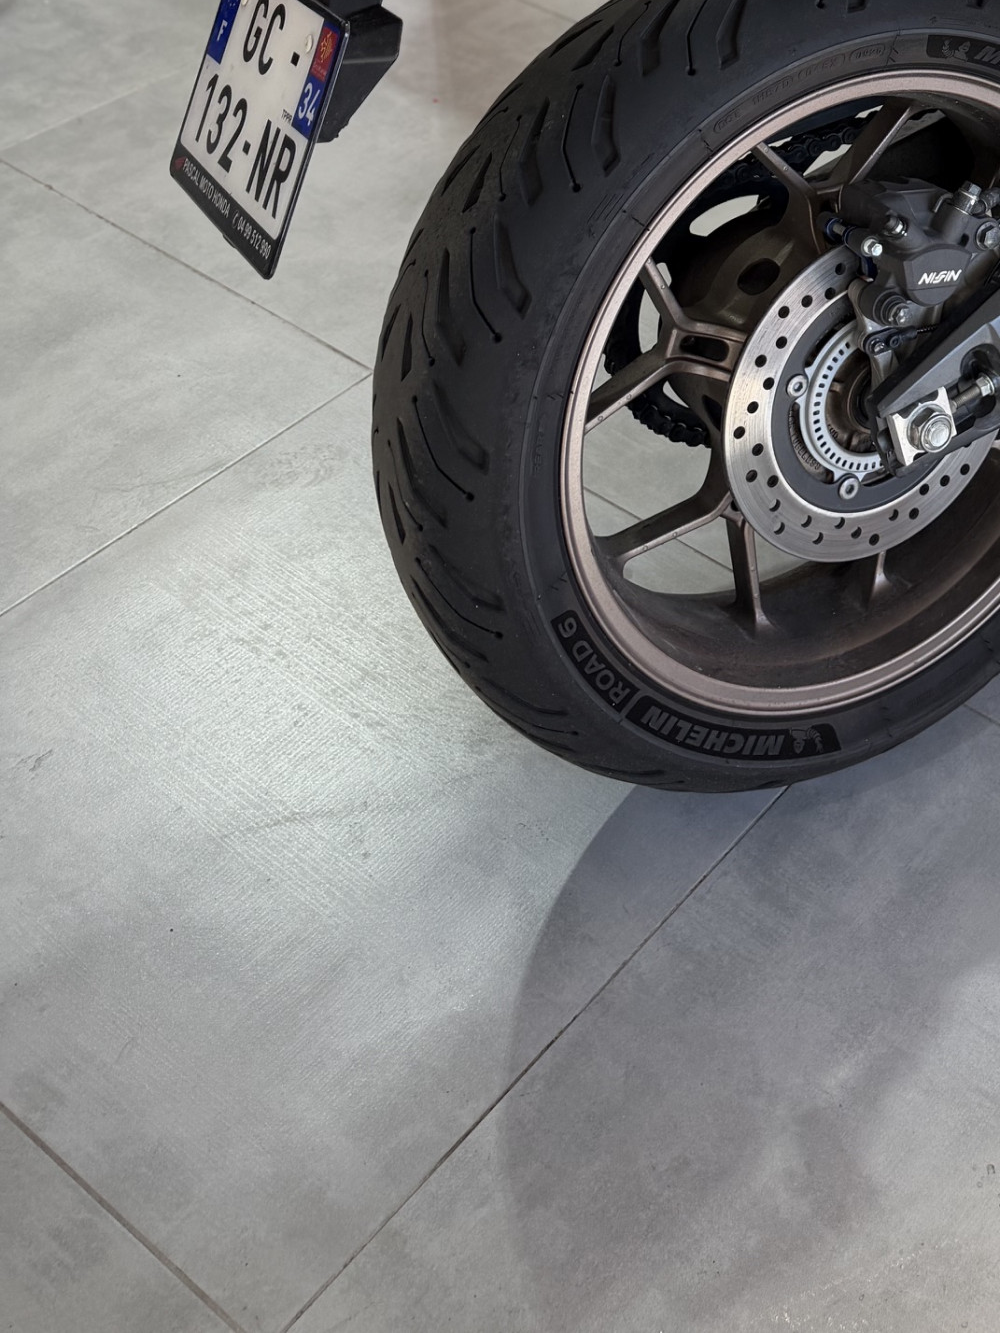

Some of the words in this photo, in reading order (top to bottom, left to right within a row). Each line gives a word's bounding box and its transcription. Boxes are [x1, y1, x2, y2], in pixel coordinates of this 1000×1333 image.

[216, 18, 229, 43] F
[298, 81, 321, 127] 34
[195, 73, 297, 220] 132-NR
[557, 616, 578, 639] 6
[571, 640, 630, 706] ROAD
[639, 703, 786, 757] MICHELIN
